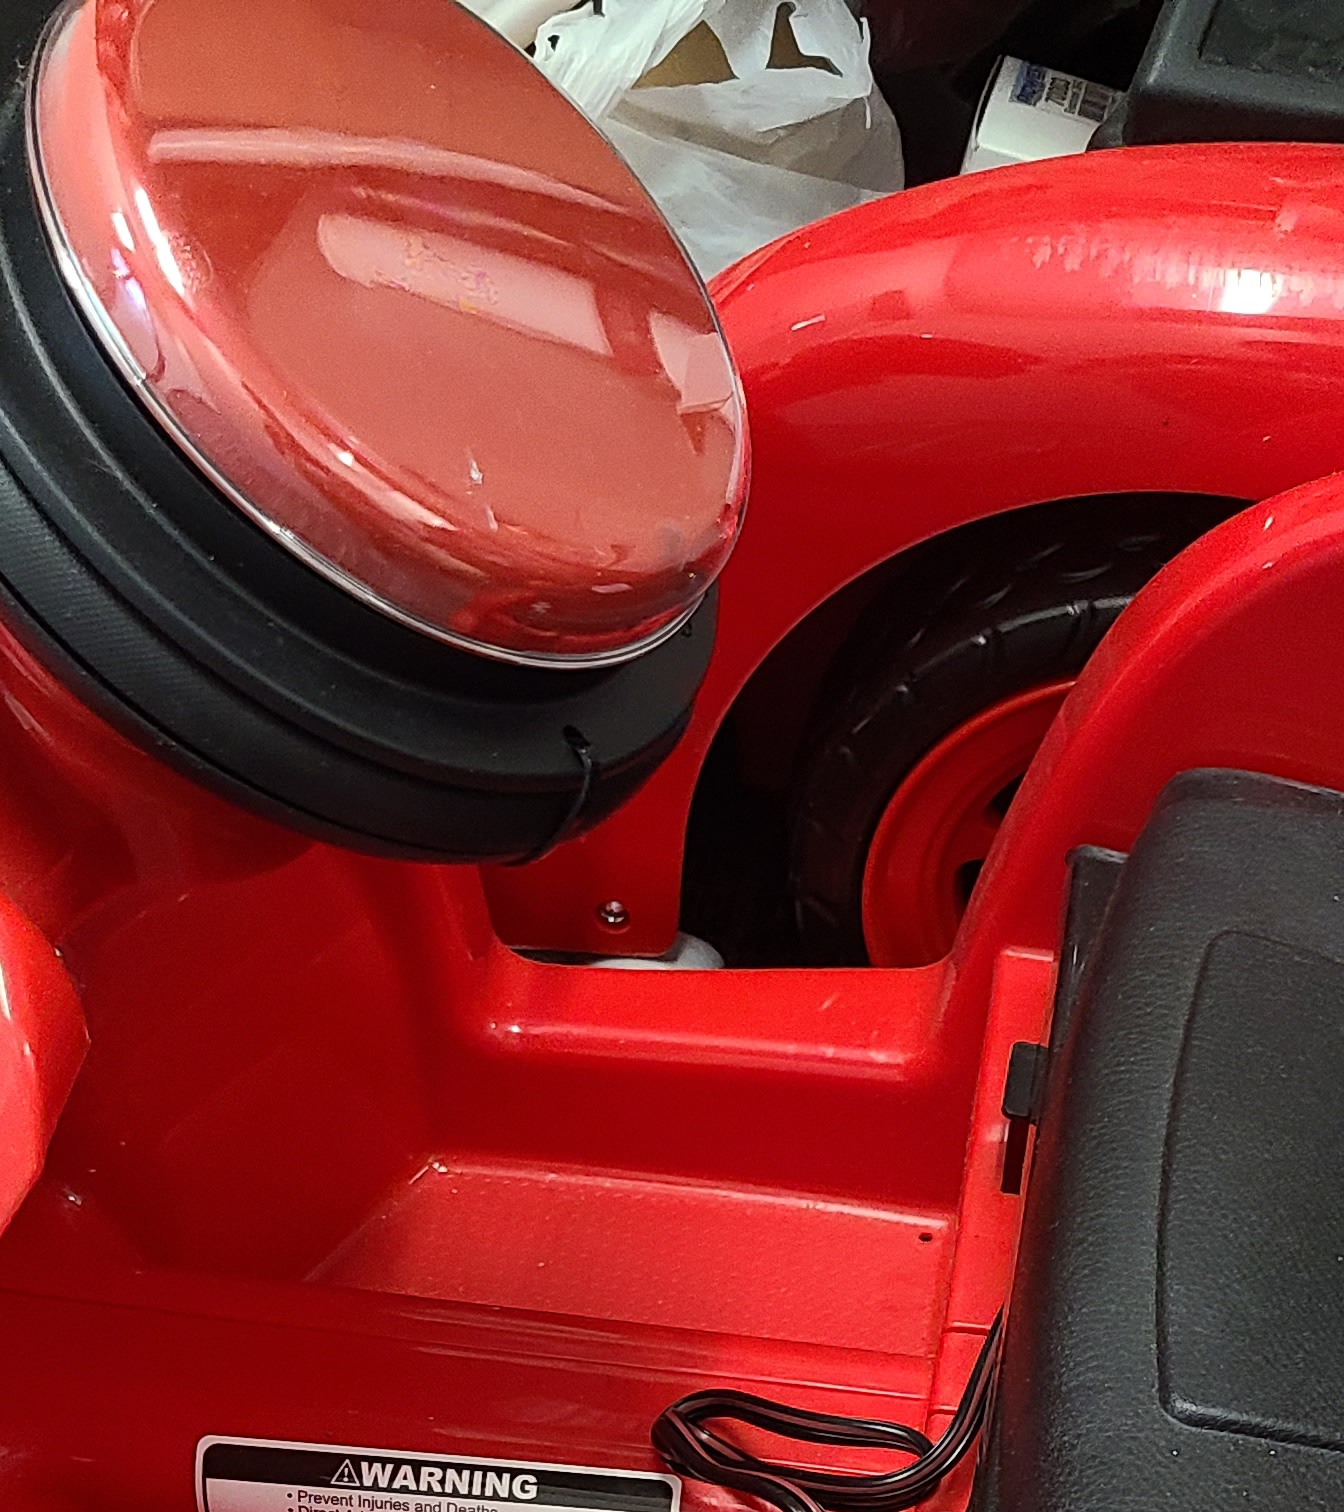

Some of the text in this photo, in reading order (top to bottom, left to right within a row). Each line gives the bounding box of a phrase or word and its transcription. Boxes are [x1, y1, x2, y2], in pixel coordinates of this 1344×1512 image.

[360, 1461, 538, 1500] WARNING
[298, 1491, 353, 1508] Prevent
[358, 1495, 409, 1512] Injuries
